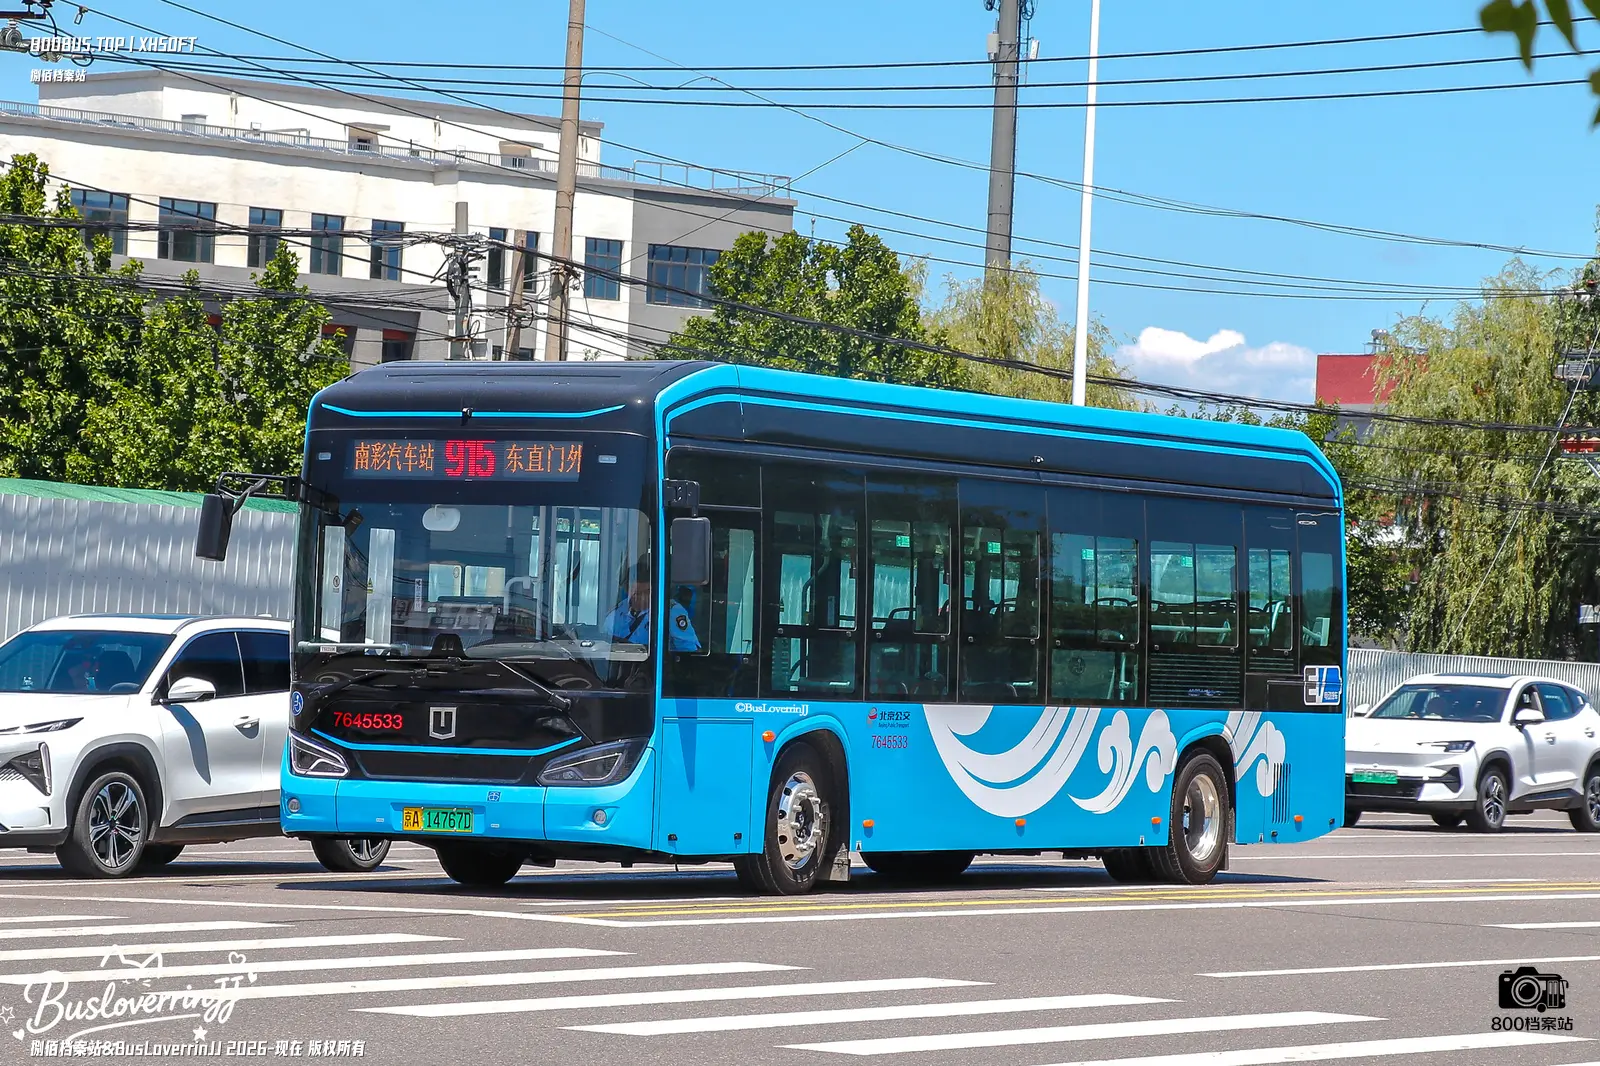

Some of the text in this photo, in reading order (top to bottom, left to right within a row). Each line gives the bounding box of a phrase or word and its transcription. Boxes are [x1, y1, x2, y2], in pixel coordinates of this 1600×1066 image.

[355, 440, 583, 476] 南彩汽车站 915 东直门外
[333, 711, 404, 730] 7645533
[879, 711, 911, 721] 北京公交
[872, 735, 908, 749] 7645533
